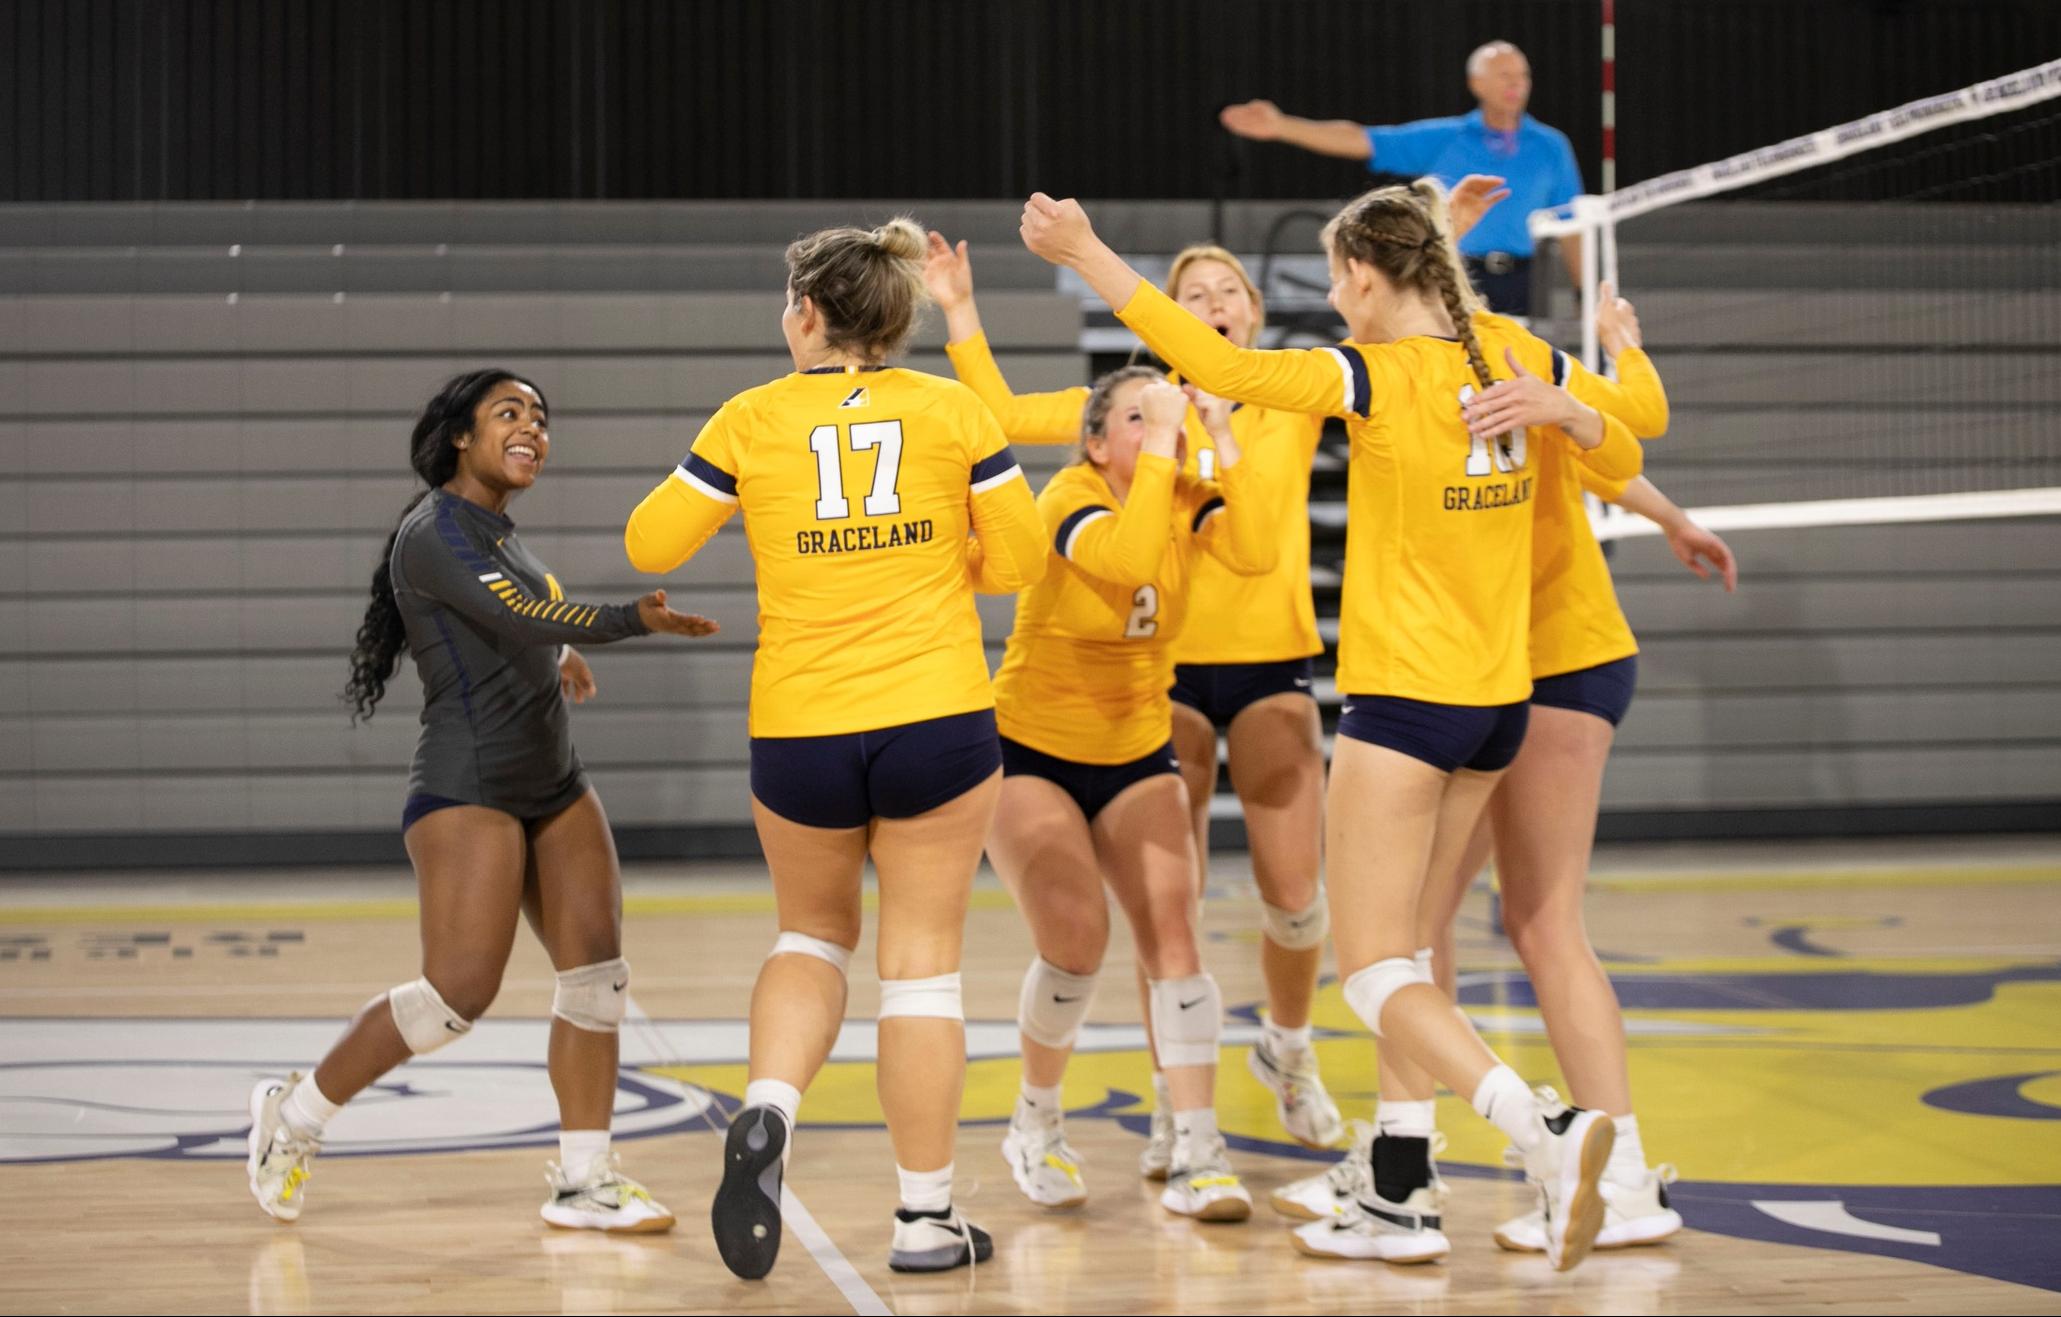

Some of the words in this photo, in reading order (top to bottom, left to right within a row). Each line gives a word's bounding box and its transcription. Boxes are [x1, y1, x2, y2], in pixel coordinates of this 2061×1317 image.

[809, 419, 904, 520] 17
[1443, 476, 1534, 511] GRACELAN
[797, 519, 933, 554] GRACELAND
[1123, 583, 1158, 637] 2
